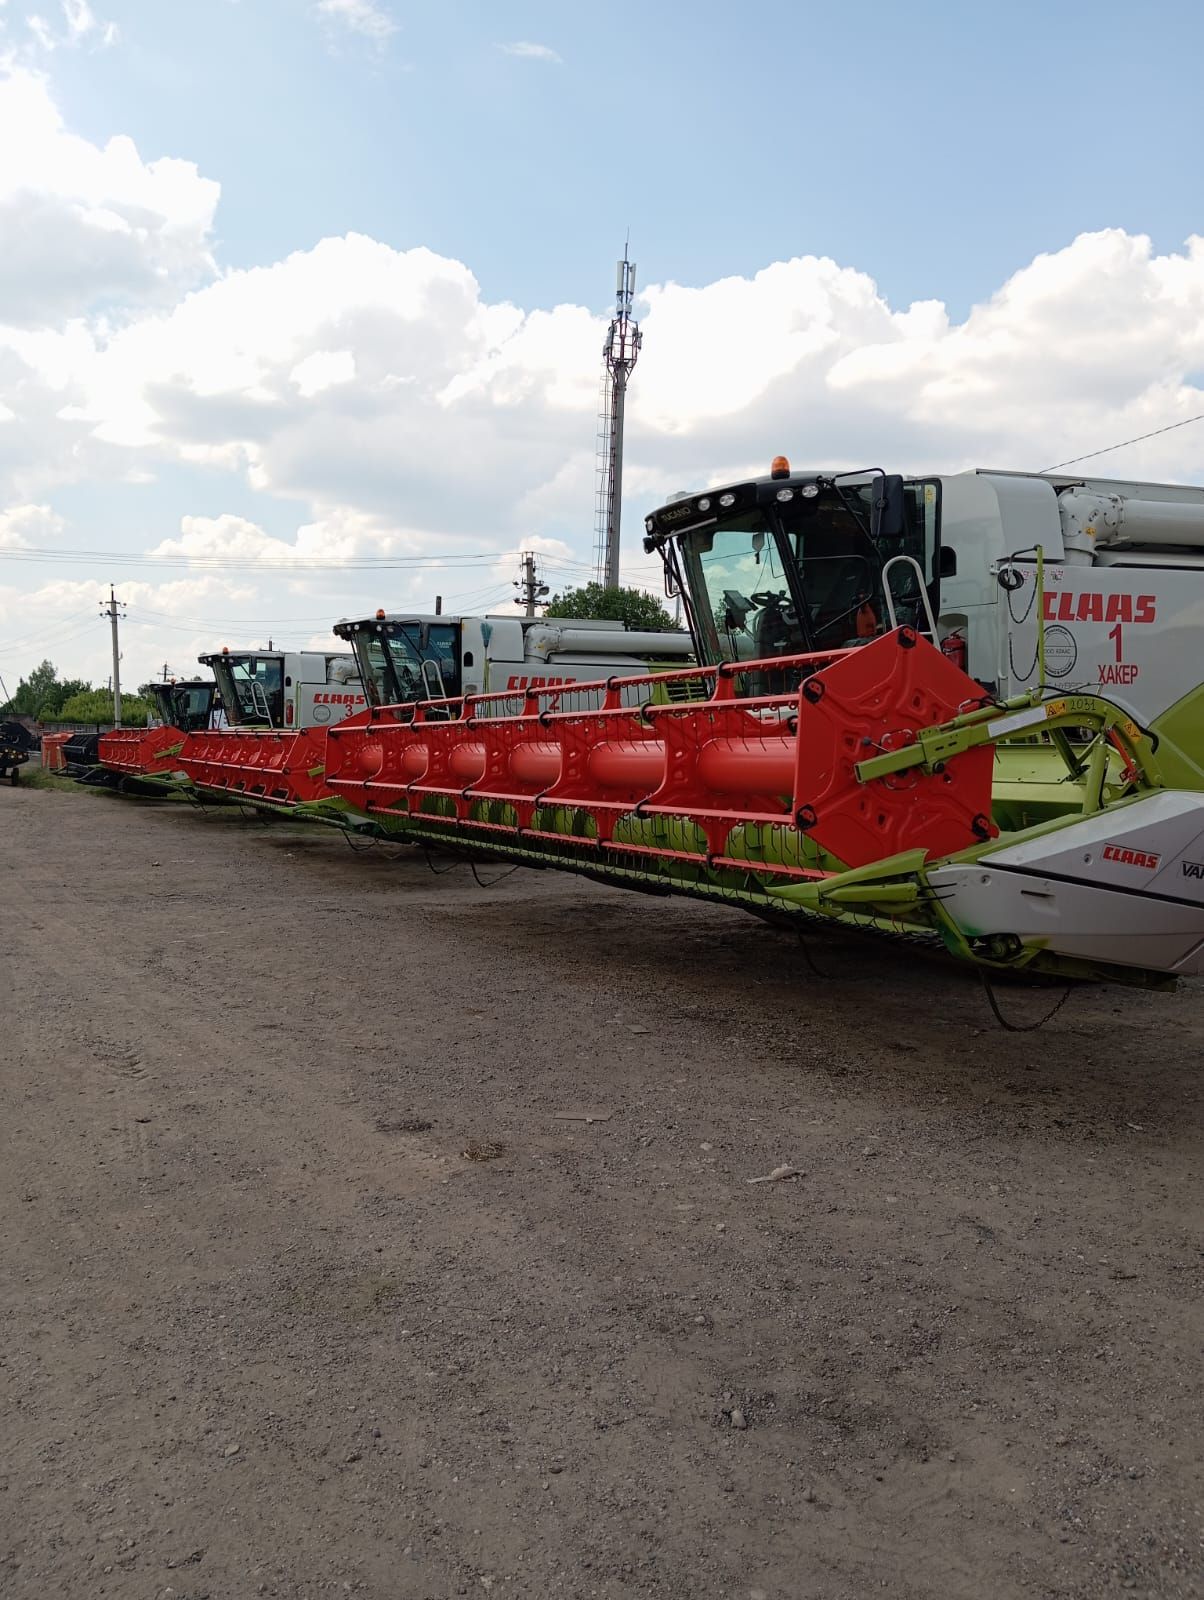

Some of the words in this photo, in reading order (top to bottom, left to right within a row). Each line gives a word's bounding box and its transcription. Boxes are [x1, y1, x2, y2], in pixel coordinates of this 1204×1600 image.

[1038, 591, 1156, 623] CLAAS
[1108, 623, 1122, 663] 1
[1098, 664, 1138, 685] ХАКЕР
[314, 694, 365, 705] CLAAS
[549, 694, 560, 710] 2
[345, 704, 354, 717] 3
[1103, 846, 1158, 869] CLAAS
